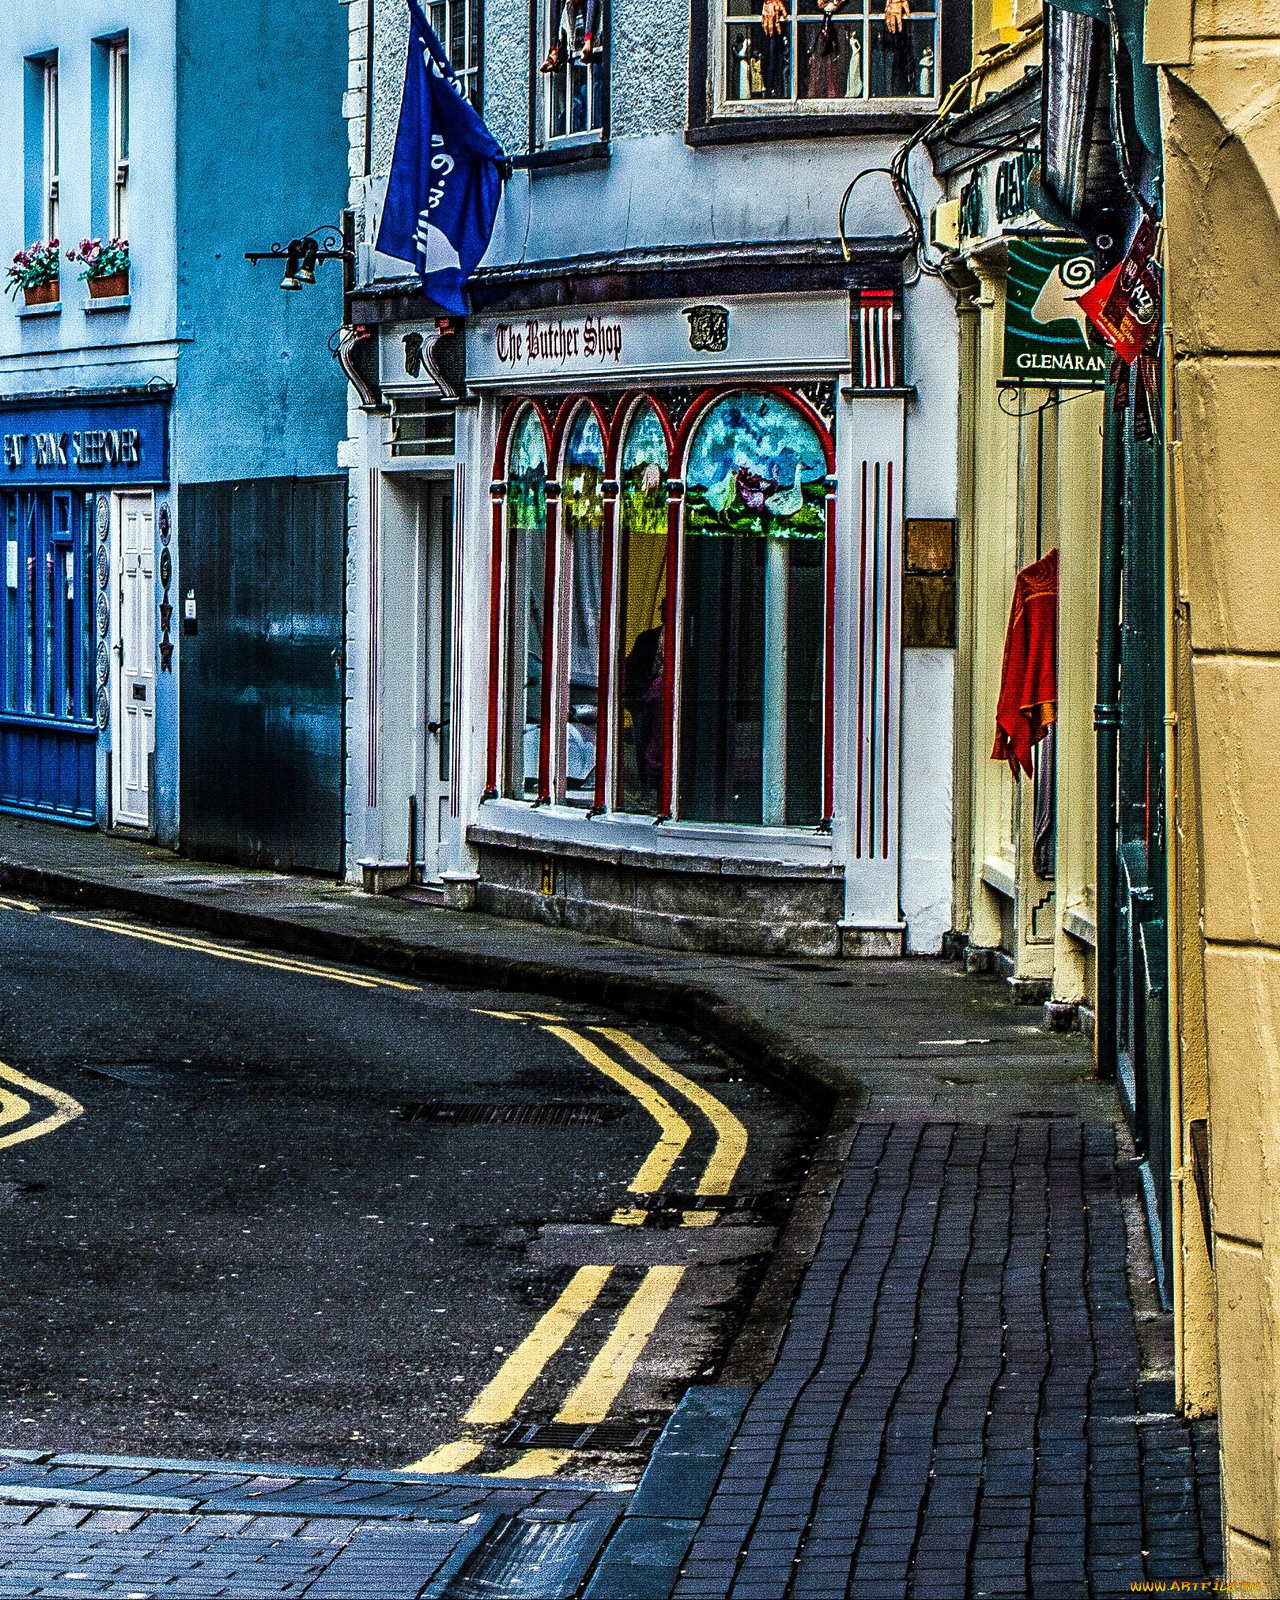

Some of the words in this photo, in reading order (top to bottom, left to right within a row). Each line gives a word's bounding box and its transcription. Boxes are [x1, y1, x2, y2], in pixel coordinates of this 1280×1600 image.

[496, 322, 522, 369] The
[525, 319, 579, 366] Butcher
[583, 314, 621, 363] Shop
